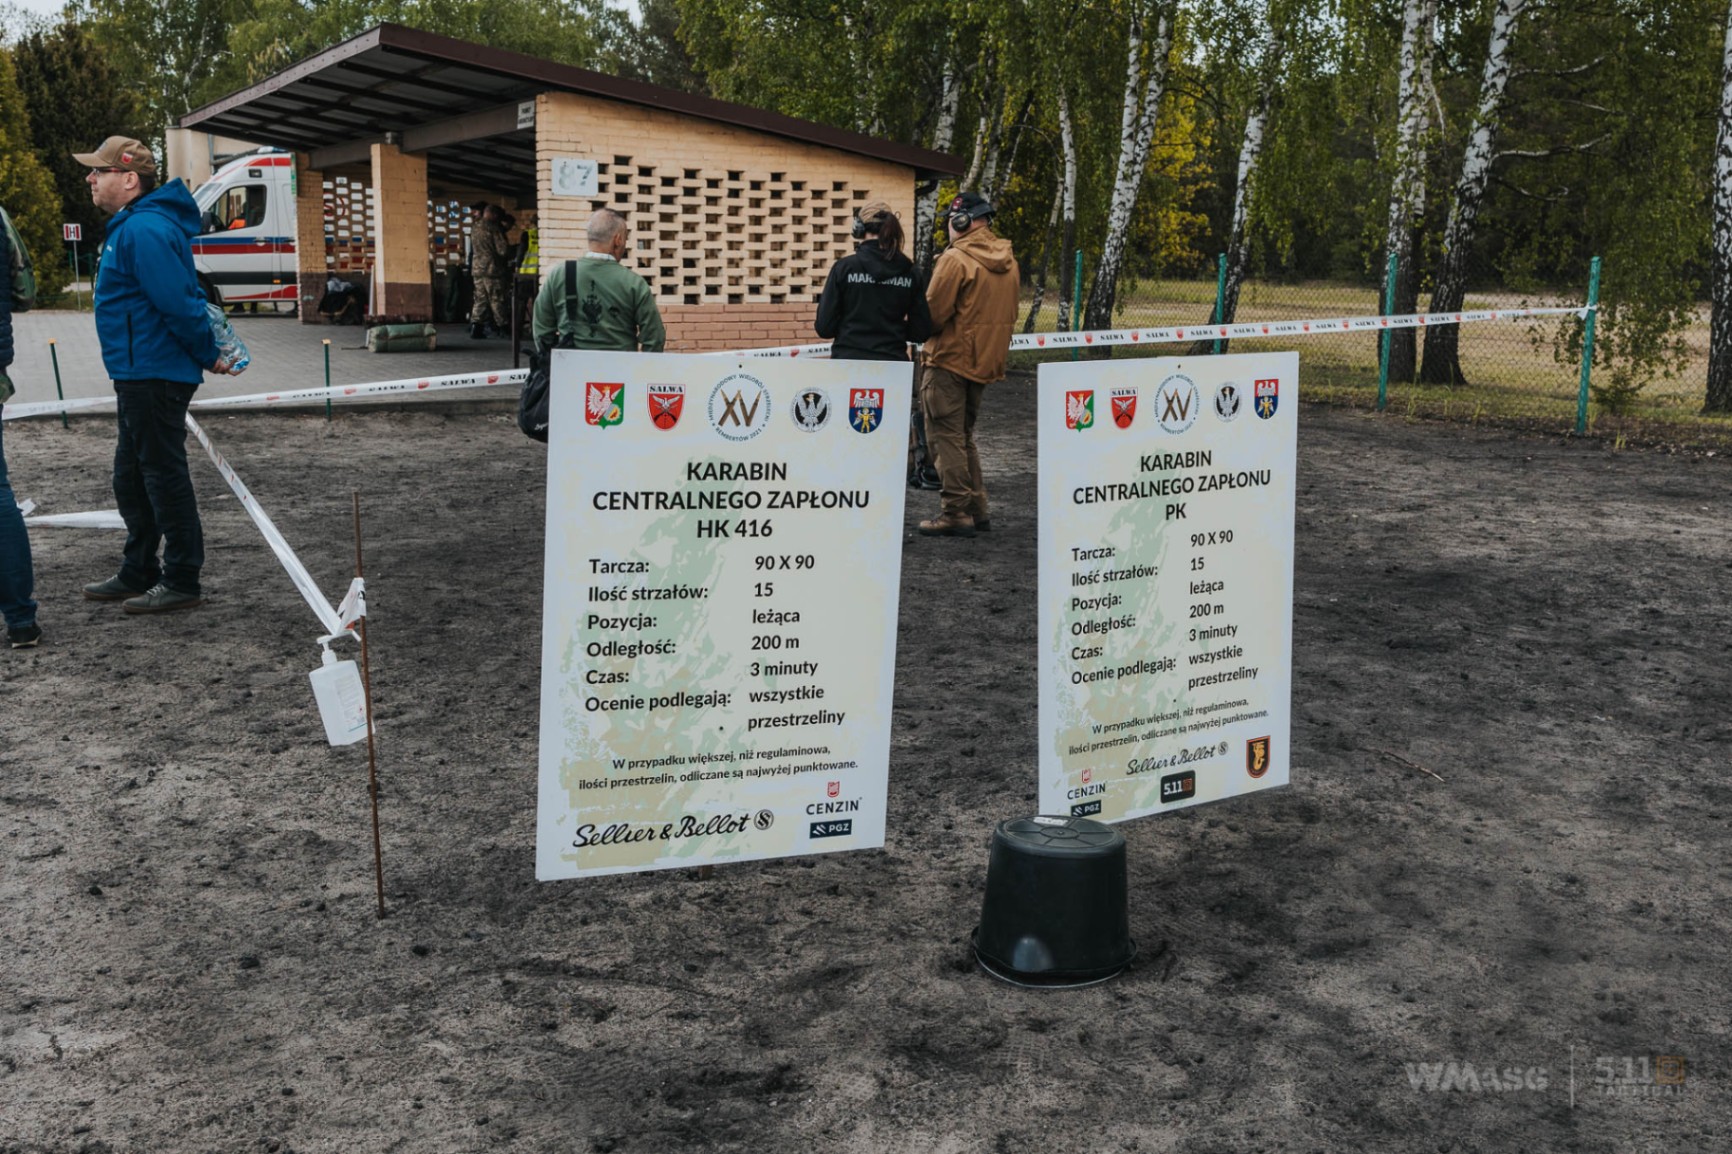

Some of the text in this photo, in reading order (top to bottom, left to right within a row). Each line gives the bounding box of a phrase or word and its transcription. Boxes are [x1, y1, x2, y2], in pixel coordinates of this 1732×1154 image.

[1141, 450, 1212, 472] KARABIN
[687, 462, 787, 481] KARABIN
[1073, 470, 1271, 504] CENTRALNEGO ZAPŁONU
[593, 491, 870, 510] CENTRALNEGO ZAPŁONU
[1166, 504, 1186, 520] PK
[697, 519, 773, 538] HK 416
[1191, 530, 1233, 547] 90 X 90
[755, 555, 814, 570] 90 X 90
[1072, 547, 1115, 561] Tarcza:
[589, 559, 649, 573] Tarcza:
[1191, 558, 1204, 571] 15
[1072, 565, 1158, 586] Ilość strzałów:
[589, 585, 708, 602] Ilość strzałów:
[754, 583, 773, 597] 15
[1190, 581, 1223, 595] leżąca
[1072, 594, 1122, 611] Pozycja:
[1190, 605, 1224, 618] 200 m
[588, 614, 657, 631] Pozycja:
[753, 610, 800, 625] leżąca
[1072, 616, 1136, 636] Odległość:
[1189, 623, 1238, 641] 3 minuty
[587, 640, 676, 658] Odległość:
[751, 635, 799, 651] 200 m
[1072, 647, 1103, 660] Czas:
[1189, 647, 1243, 665] wszystkie
[586, 669, 629, 684] Czas:
[751, 660, 818, 678] 3 minuty
[1072, 658, 1176, 684] Ocenie podlegają:
[1188, 666, 1258, 690] przestrzeliny
[585, 691, 731, 712] Ocenie podlegają:
[749, 686, 824, 705] wszystkie
[748, 710, 845, 731] przestrzeliny
[1092, 725, 1101, 735] W
[1104, 718, 1145, 734] przypadku
[1183, 707, 1193, 717] niż
[1195, 698, 1248, 715] regulaminowa,
[1069, 744, 1090, 755] ilości
[1141, 727, 1177, 742] odliczane
[1178, 725, 1186, 736] są
[1188, 717, 1221, 732] najwyżej
[1223, 710, 1268, 726] punktowane.
[613, 744, 831, 770] W przypadku większej, niż regulaminowa,
[1170, 756, 1176, 766] &
[1178, 745, 1215, 764] Bellot
[579, 759, 858, 790] ilości przestrzelin, odliczane są najwyżej punktowane.
[1068, 783, 1106, 800] CENZIN
[806, 800, 860, 816] CENZIN
[1084, 804, 1100, 813] PGZ
[573, 812, 750, 848] Sellier & Bellot
[828, 823, 849, 832] PGZ
